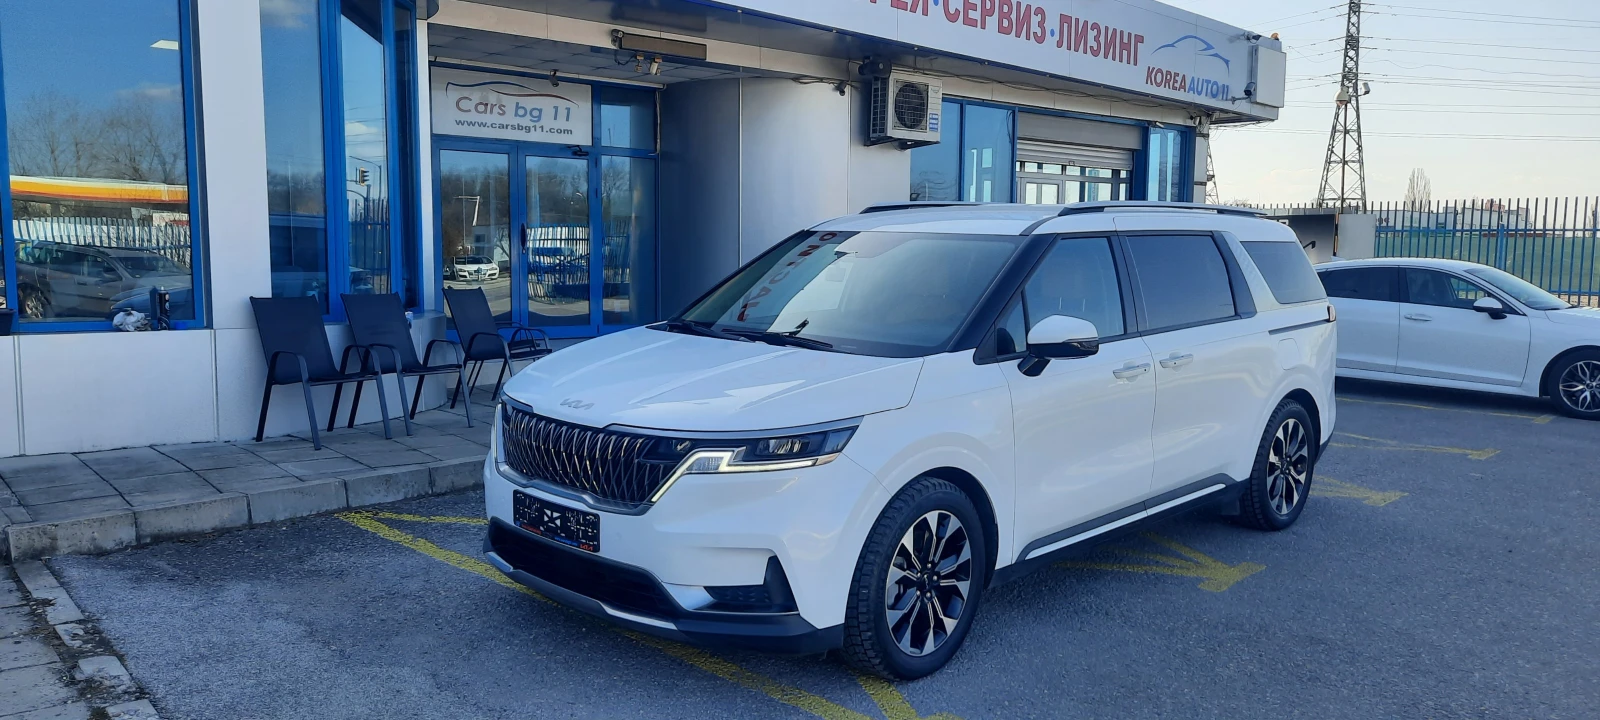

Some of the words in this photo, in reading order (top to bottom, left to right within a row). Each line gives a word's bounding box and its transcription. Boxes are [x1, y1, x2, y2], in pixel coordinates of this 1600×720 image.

[942, 0, 1046, 44] СЕРВИЗ
[1056, 13, 1144, 66] ЛИЗИНГ
[455, 96, 507, 116] Cars
[514, 102, 543, 123] bg
[552, 105, 571, 122] 11
[455, 119, 573, 135] www.carsbg11.com
